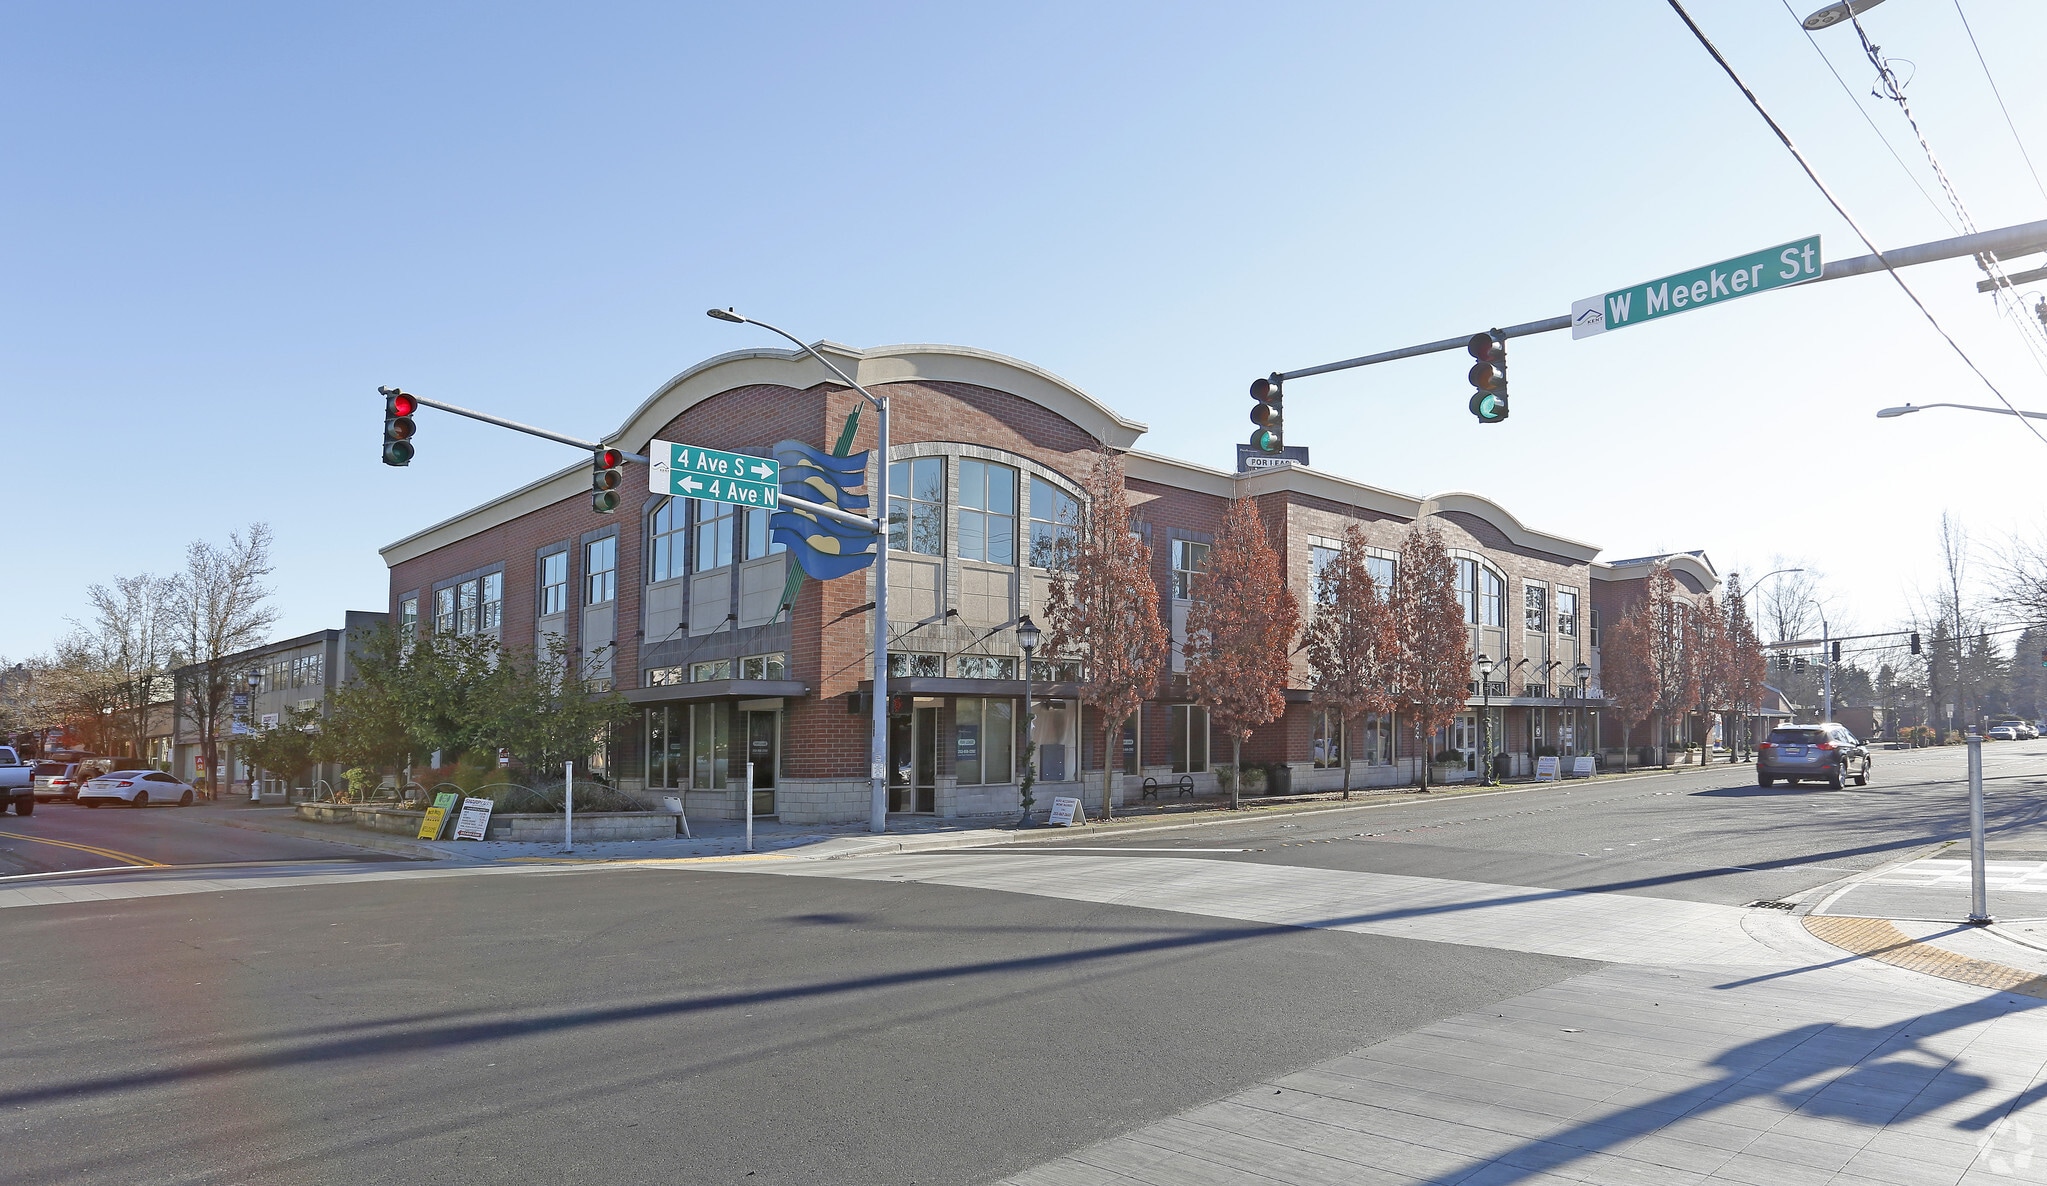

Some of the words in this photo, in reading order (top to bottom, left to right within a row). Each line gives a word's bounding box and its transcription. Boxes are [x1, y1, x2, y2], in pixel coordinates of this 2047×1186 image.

[1609, 292, 1632, 324] W
[1646, 263, 1764, 316] Meeker
[1779, 243, 1816, 280] St
[1587, 316, 1604, 324] KENT
[677, 449, 689, 468] 4
[696, 451, 728, 474] Ave
[734, 458, 745, 476] S
[1251, 458, 1268, 466] FOR
[708, 479, 720, 498] 4
[727, 481, 758, 503] Ave
[764, 487, 775, 506] N
